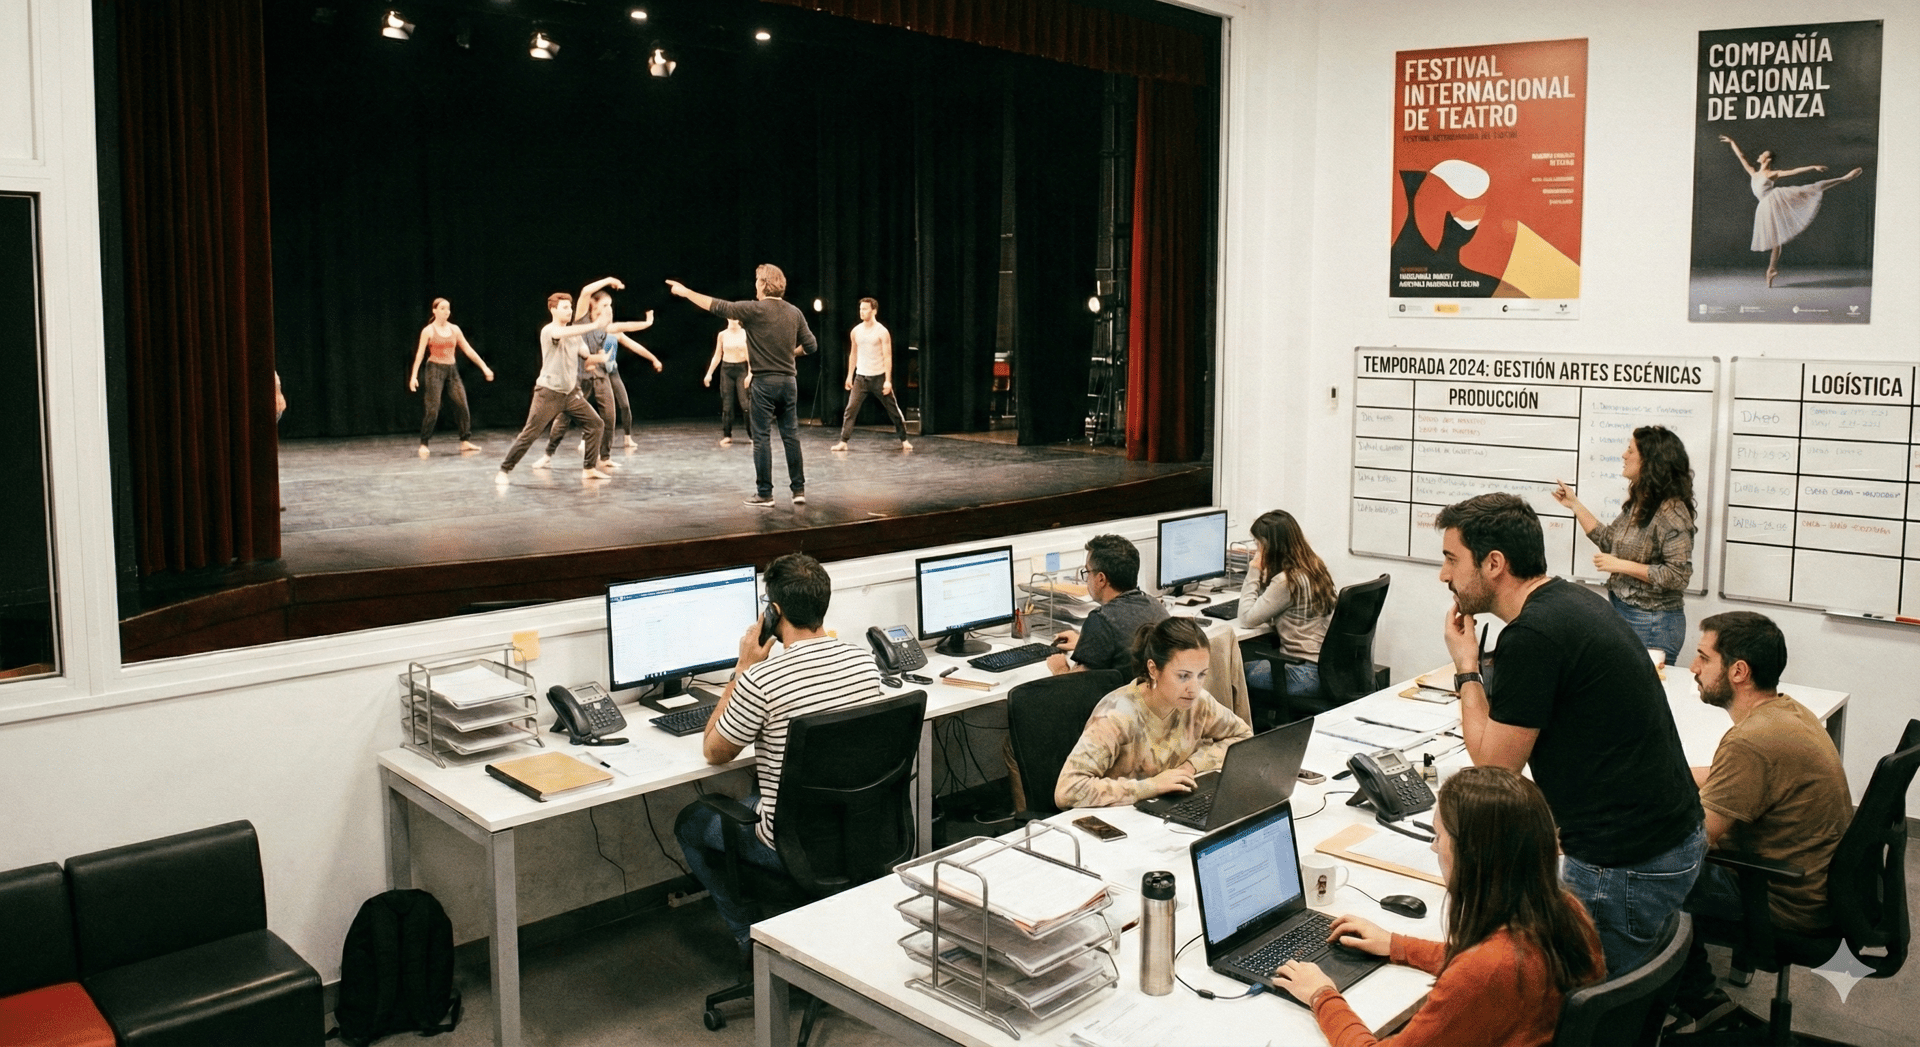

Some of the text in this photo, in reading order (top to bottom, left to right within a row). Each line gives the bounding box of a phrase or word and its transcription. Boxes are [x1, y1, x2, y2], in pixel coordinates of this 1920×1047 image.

[1709, 31, 1833, 68] COMPAÑÍA
[1405, 55, 1503, 82] FESTIVAL
[1708, 66, 1831, 95] NACIONAL
[1404, 75, 1576, 107] INTERNACIONAL
[1404, 103, 1518, 131] DE TEATRO
[1707, 93, 1825, 122] DE DANZA
[1363, 355, 1702, 385] TEMPORADA 2024: GESTIÓN ARTES ESCÉNICAS
[1811, 371, 1903, 398] LOGÍSTICA
[1449, 387, 1539, 410] PRODUCCIÓN
